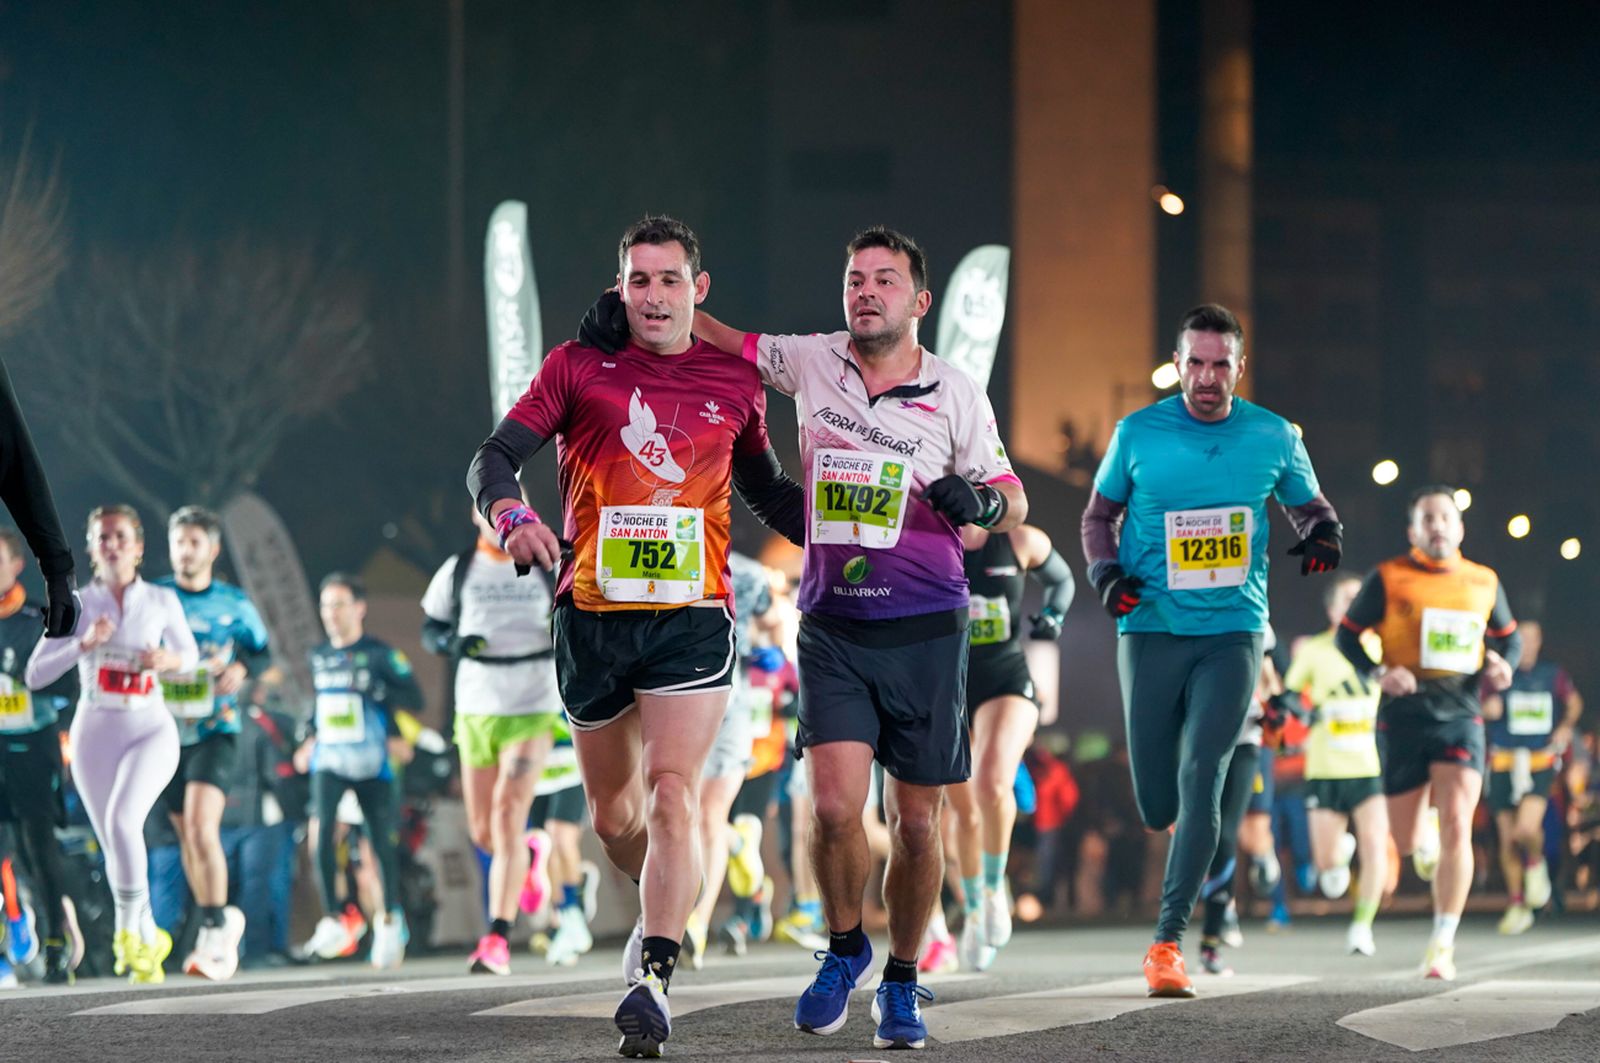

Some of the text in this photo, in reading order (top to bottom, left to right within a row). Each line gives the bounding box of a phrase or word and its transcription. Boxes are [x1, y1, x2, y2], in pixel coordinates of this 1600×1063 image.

[855, 424, 868, 437] DE
[863, 427, 916, 456] SEGURA
[639, 440, 666, 467] 43
[832, 459, 860, 471] NOCHE
[861, 462, 874, 472] DE
[821, 470, 838, 481] SAN
[824, 483, 892, 517] 12792
[622, 516, 655, 526] NOCHE
[656, 517, 669, 527] DE
[1213, 518, 1222, 526] DE
[610, 526, 669, 539] SAN ANTÓN
[1176, 529, 1193, 537] SAN
[1179, 535, 1242, 562] 12316
[628, 541, 676, 570] 752
